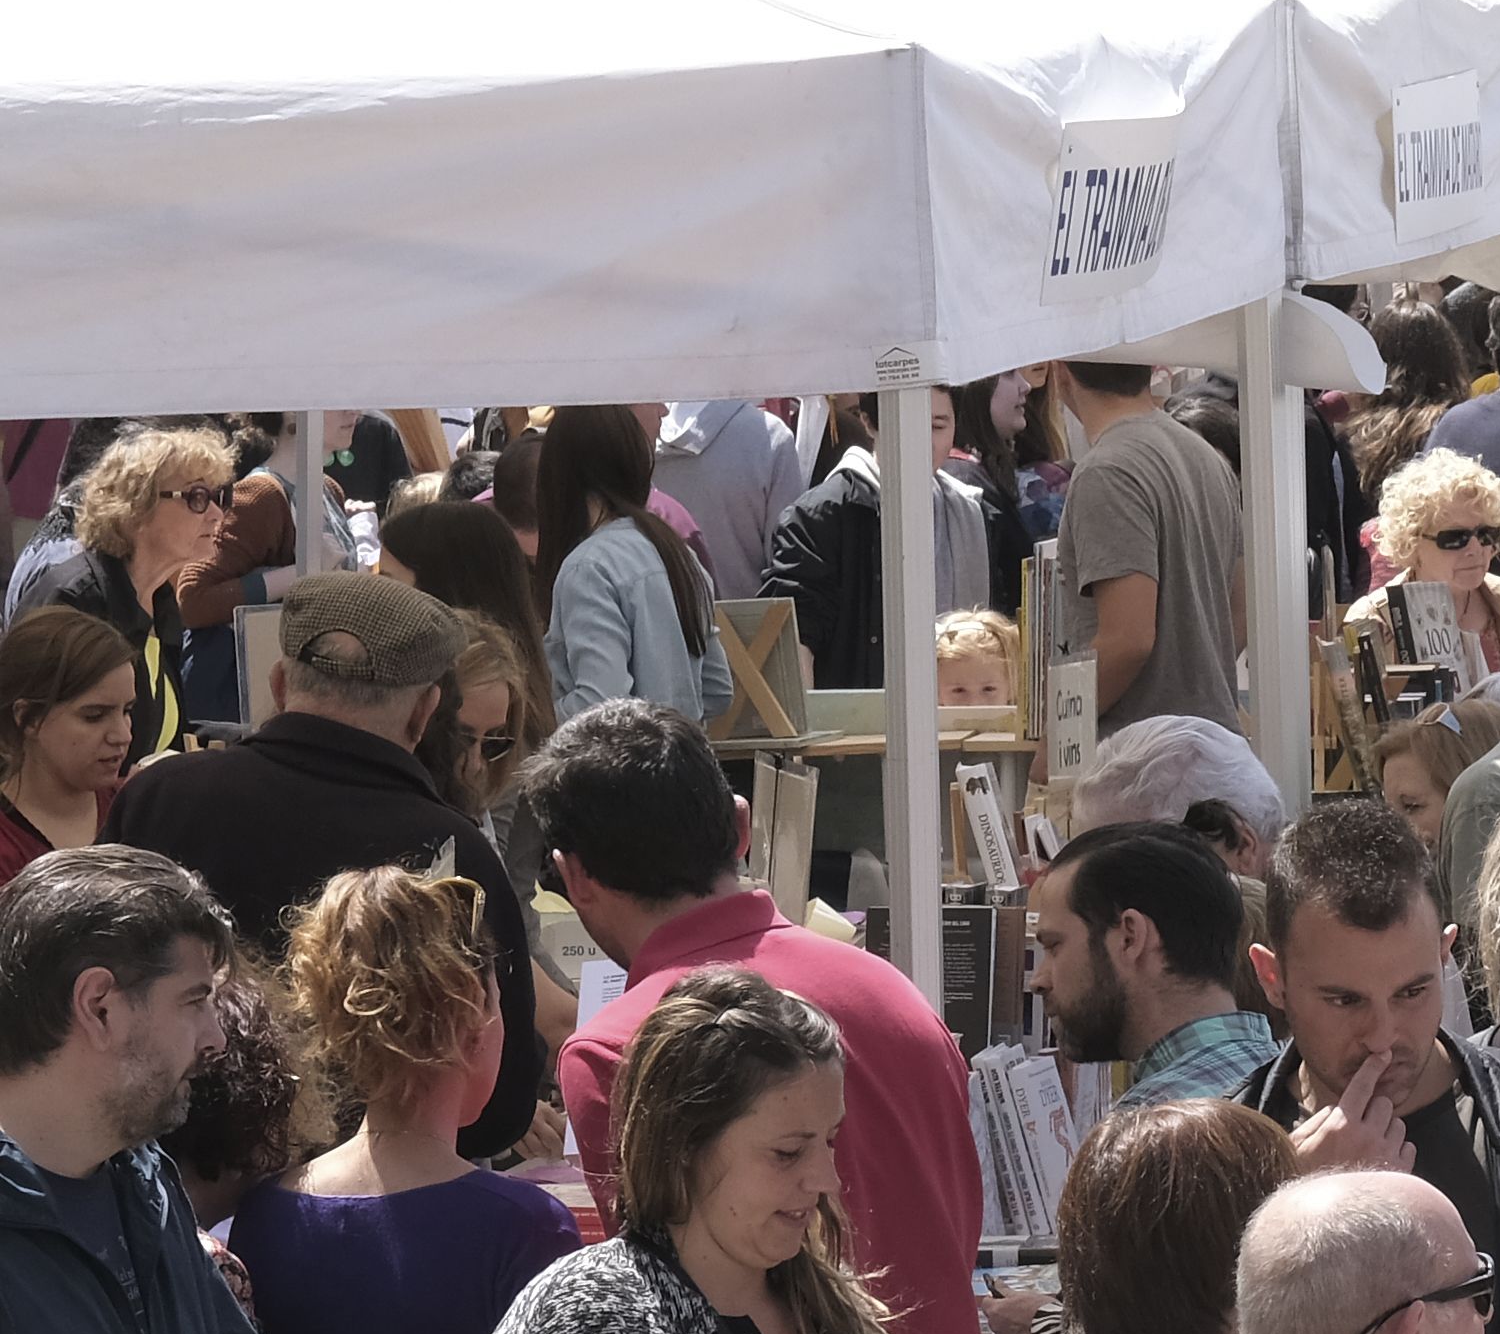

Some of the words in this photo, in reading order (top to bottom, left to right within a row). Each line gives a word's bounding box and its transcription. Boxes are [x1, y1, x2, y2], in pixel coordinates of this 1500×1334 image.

[1397, 132, 1410, 202] EL
[1410, 126, 1450, 201] TRAMVIA
[1050, 169, 1078, 277] EL
[1075, 163, 1162, 274] TRAMVIA
[1056, 689, 1083, 721] Cuina
[1063, 740, 1082, 768] vins
[562, 946, 585, 957] 250
[1015, 1088, 1031, 1118] DYER
